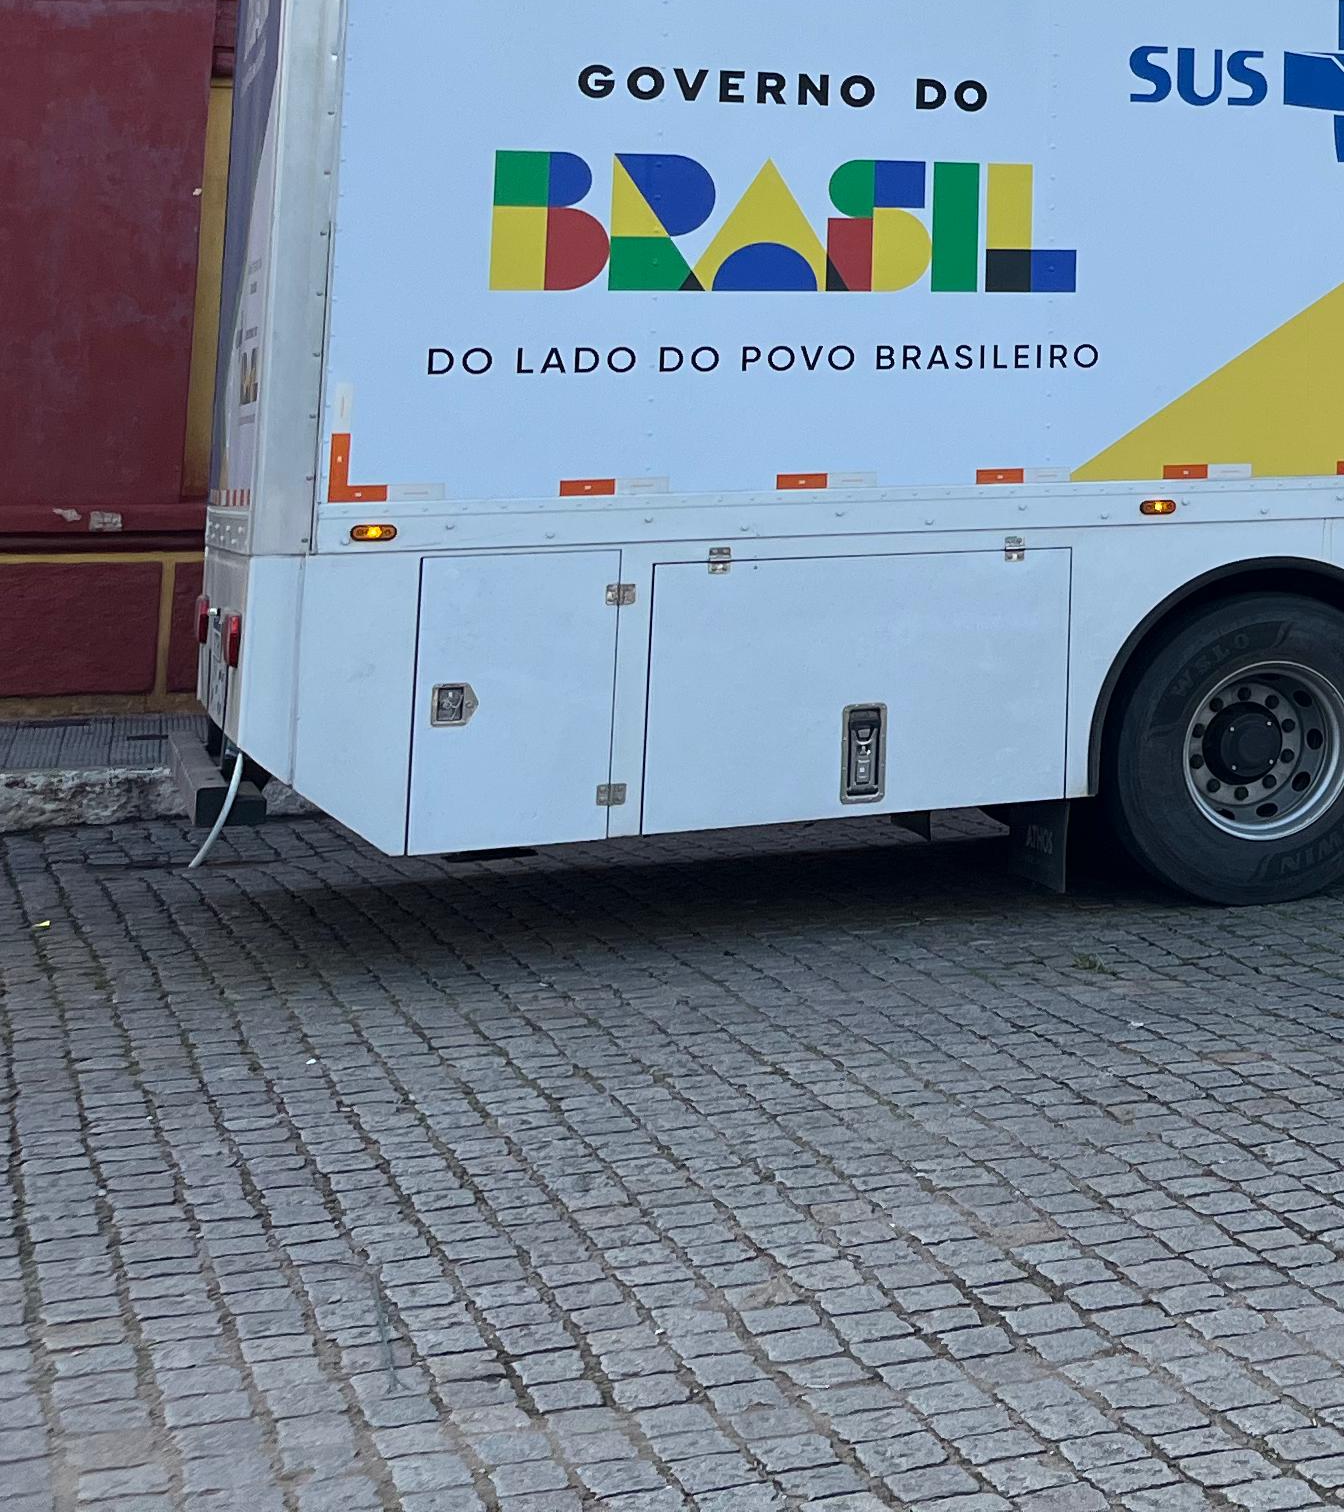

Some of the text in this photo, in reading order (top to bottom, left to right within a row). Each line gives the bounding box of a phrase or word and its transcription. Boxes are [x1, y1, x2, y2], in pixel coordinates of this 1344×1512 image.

[577, 64, 988, 113] GOVERNO DO
[1129, 45, 1268, 107] SUS
[489, 149, 1077, 293] BRASIL
[427, 343, 1099, 375] DO LADO DO POVO BRASILEIRO
